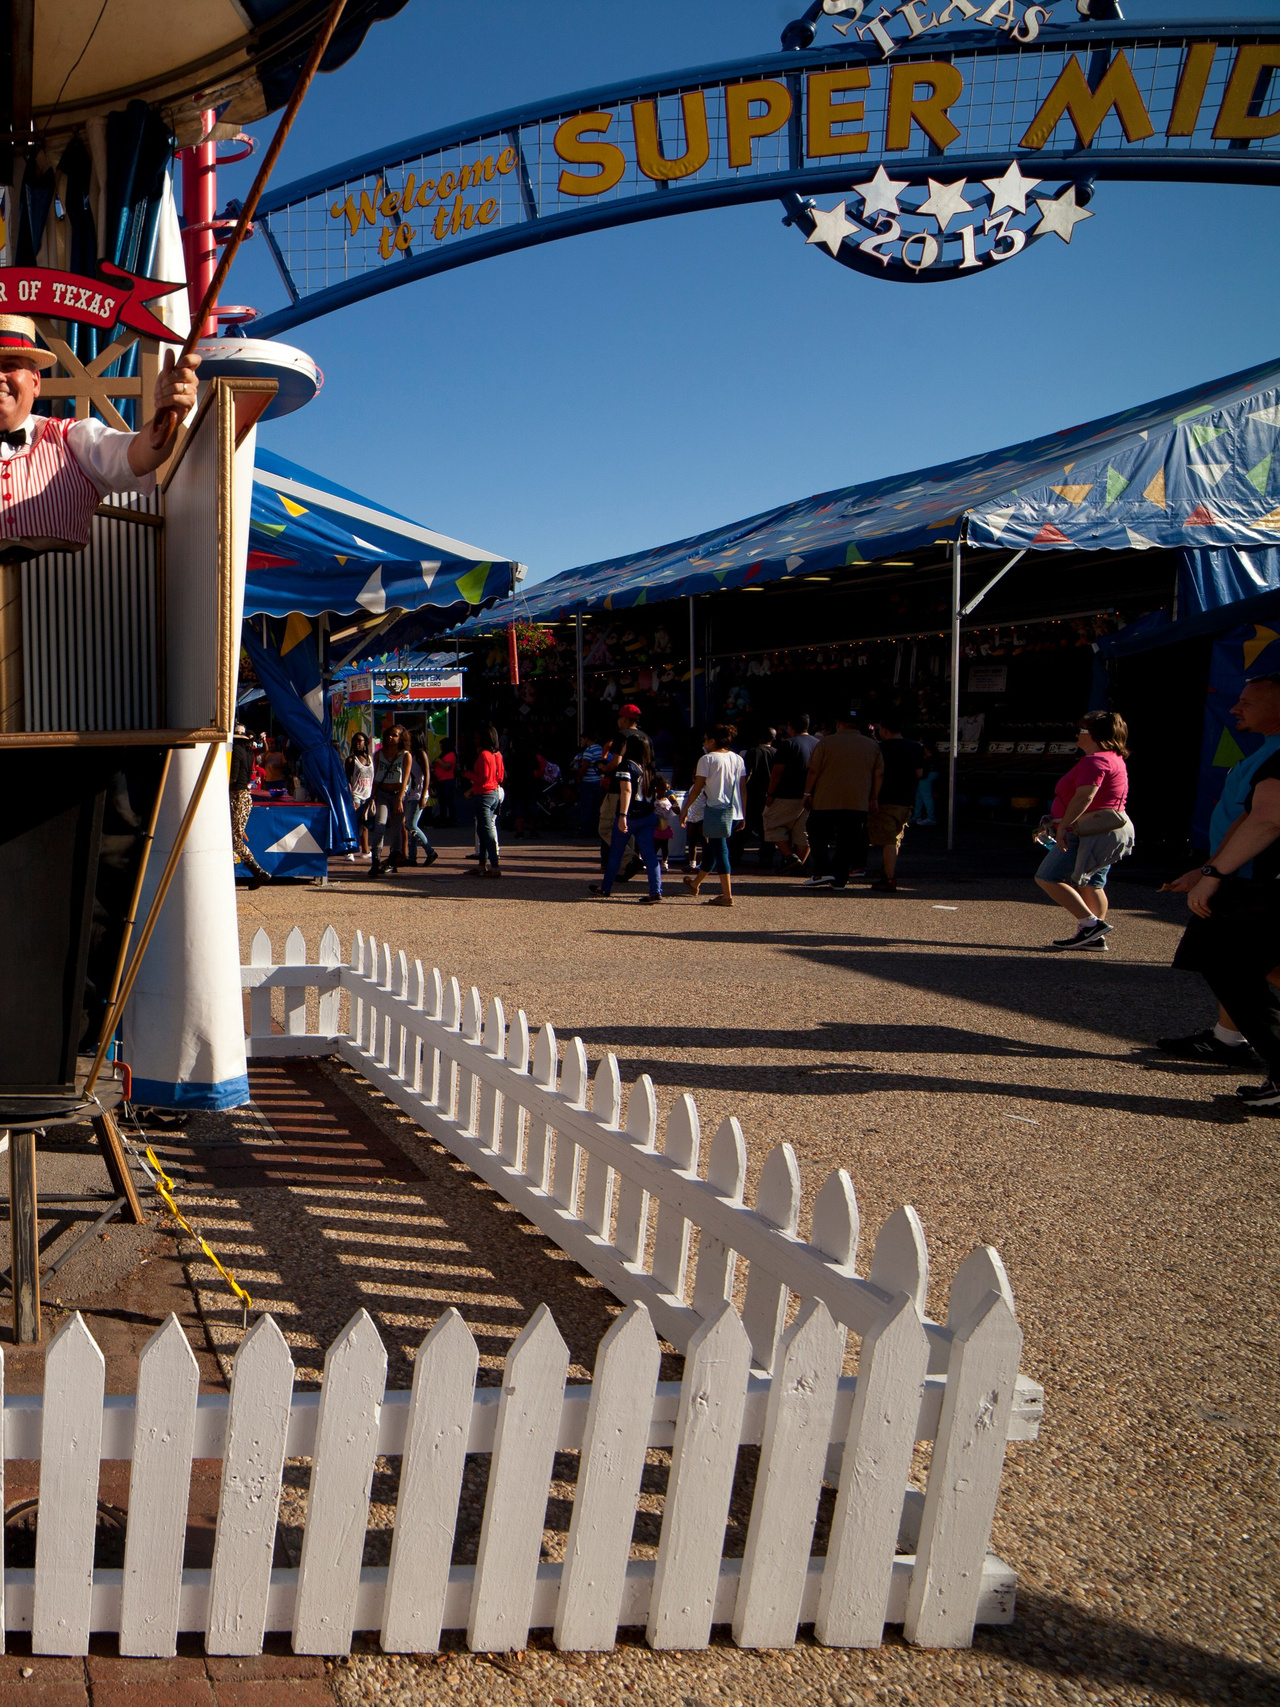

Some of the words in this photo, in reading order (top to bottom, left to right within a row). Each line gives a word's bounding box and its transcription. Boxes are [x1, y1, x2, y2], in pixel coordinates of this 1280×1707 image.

[856, 0, 1054, 59] TEXAS
[554, 60, 964, 197] SUPER
[1018, 42, 1280, 152] MID
[330, 147, 518, 237] Welcome
[378, 221, 417, 260] to
[431, 194, 499, 240] the
[858, 209, 1026, 275] 2013
[18, 280, 42, 301] OF
[52, 282, 115, 318] TEXAS
[410, 674, 424, 682] BIG
